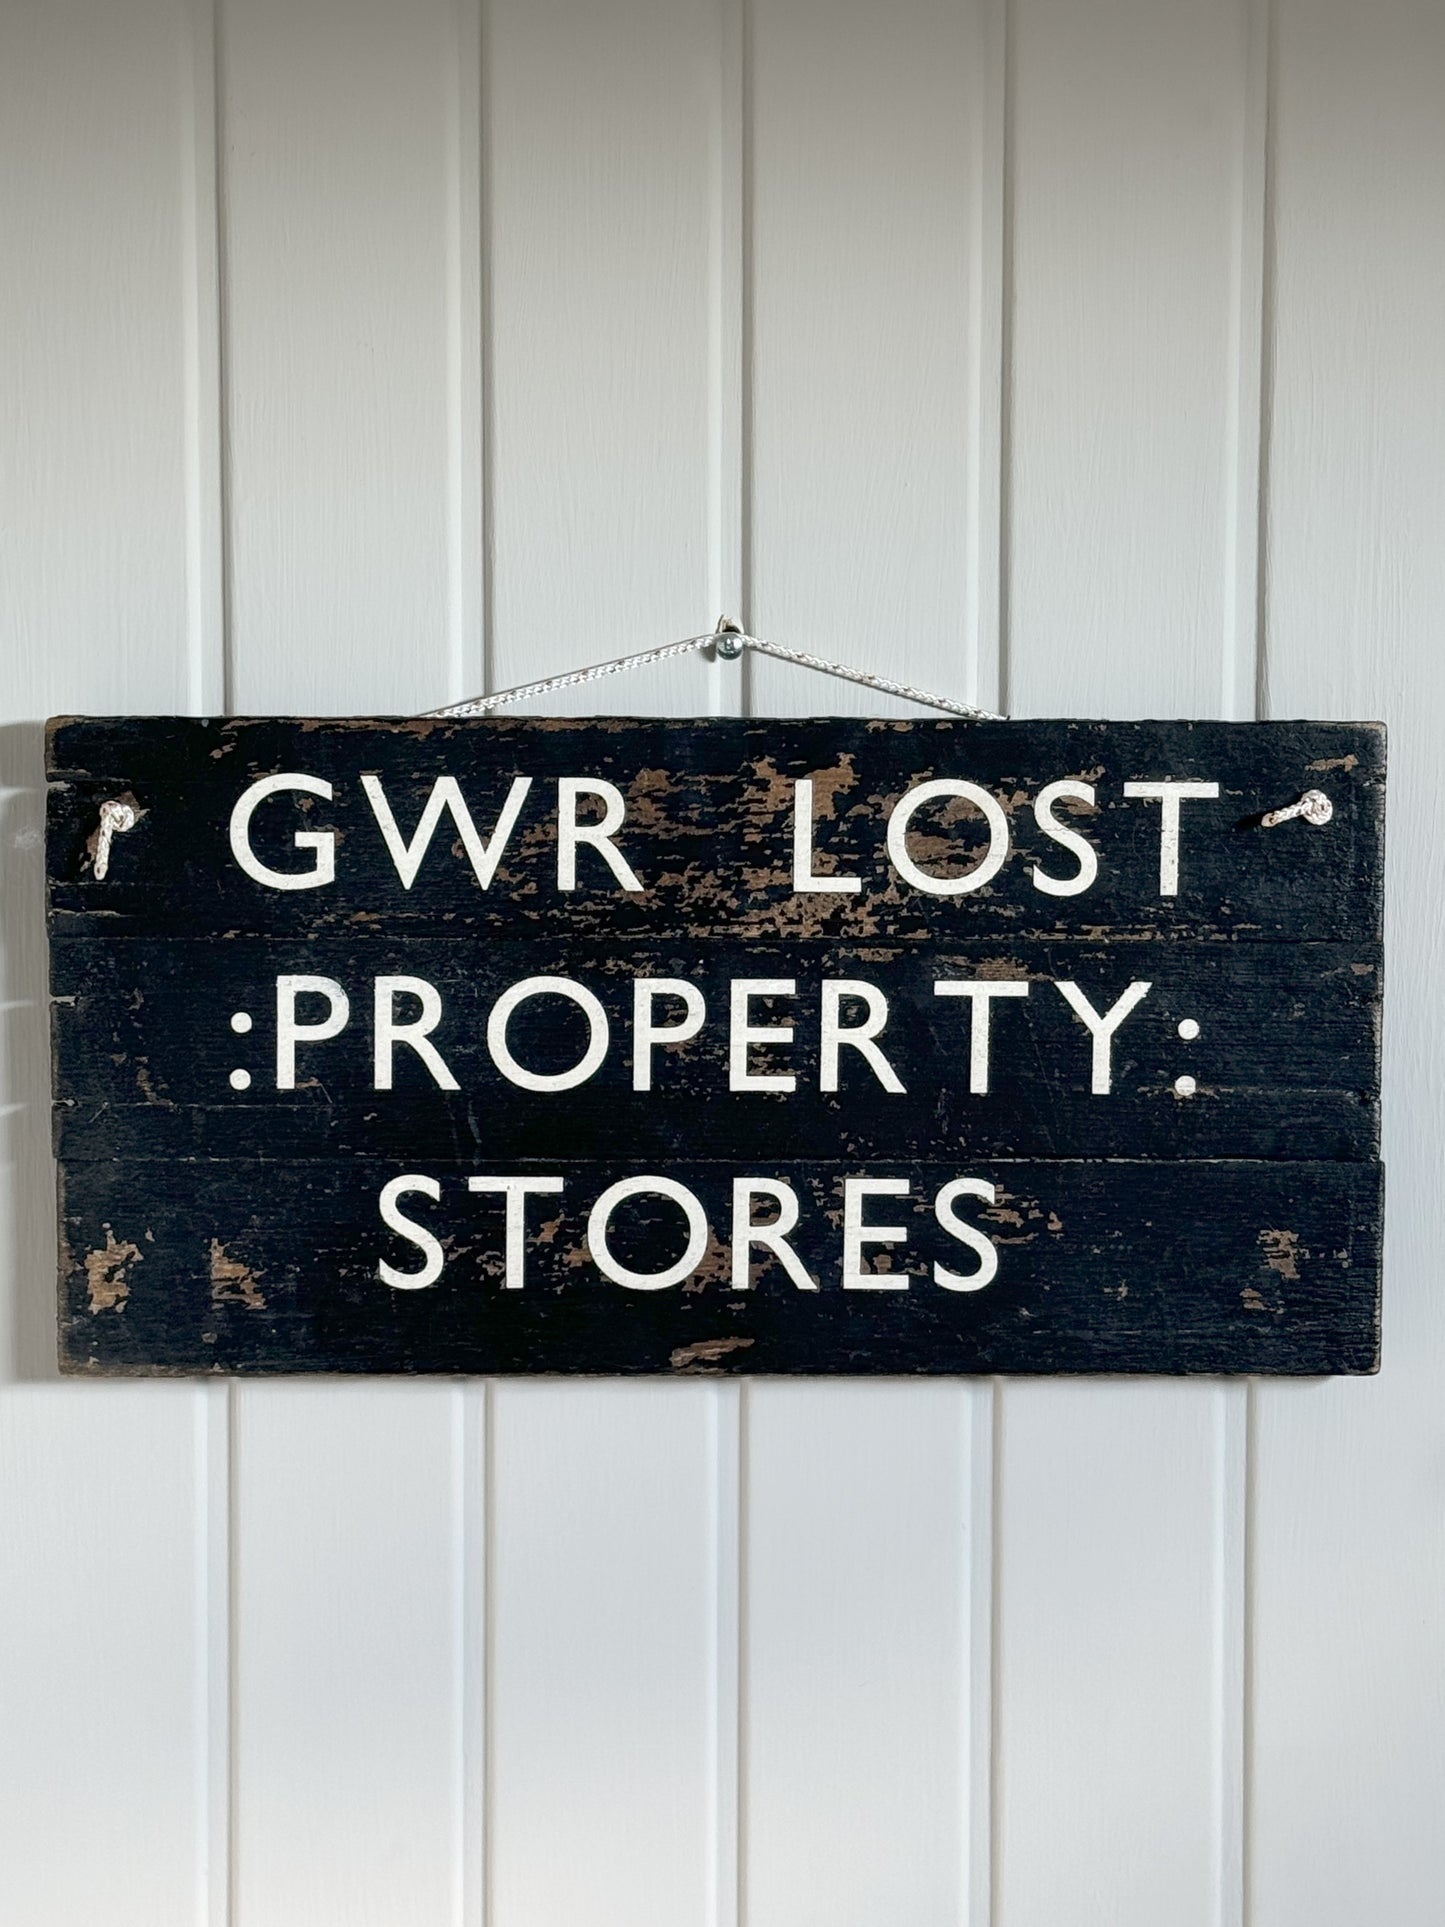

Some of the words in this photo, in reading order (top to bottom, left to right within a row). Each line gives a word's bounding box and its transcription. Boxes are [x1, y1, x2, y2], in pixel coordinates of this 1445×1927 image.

[229, 772, 645, 892] GWR
[793, 778, 1220, 897] LOST
[378, 1174, 999, 1293] STORES
